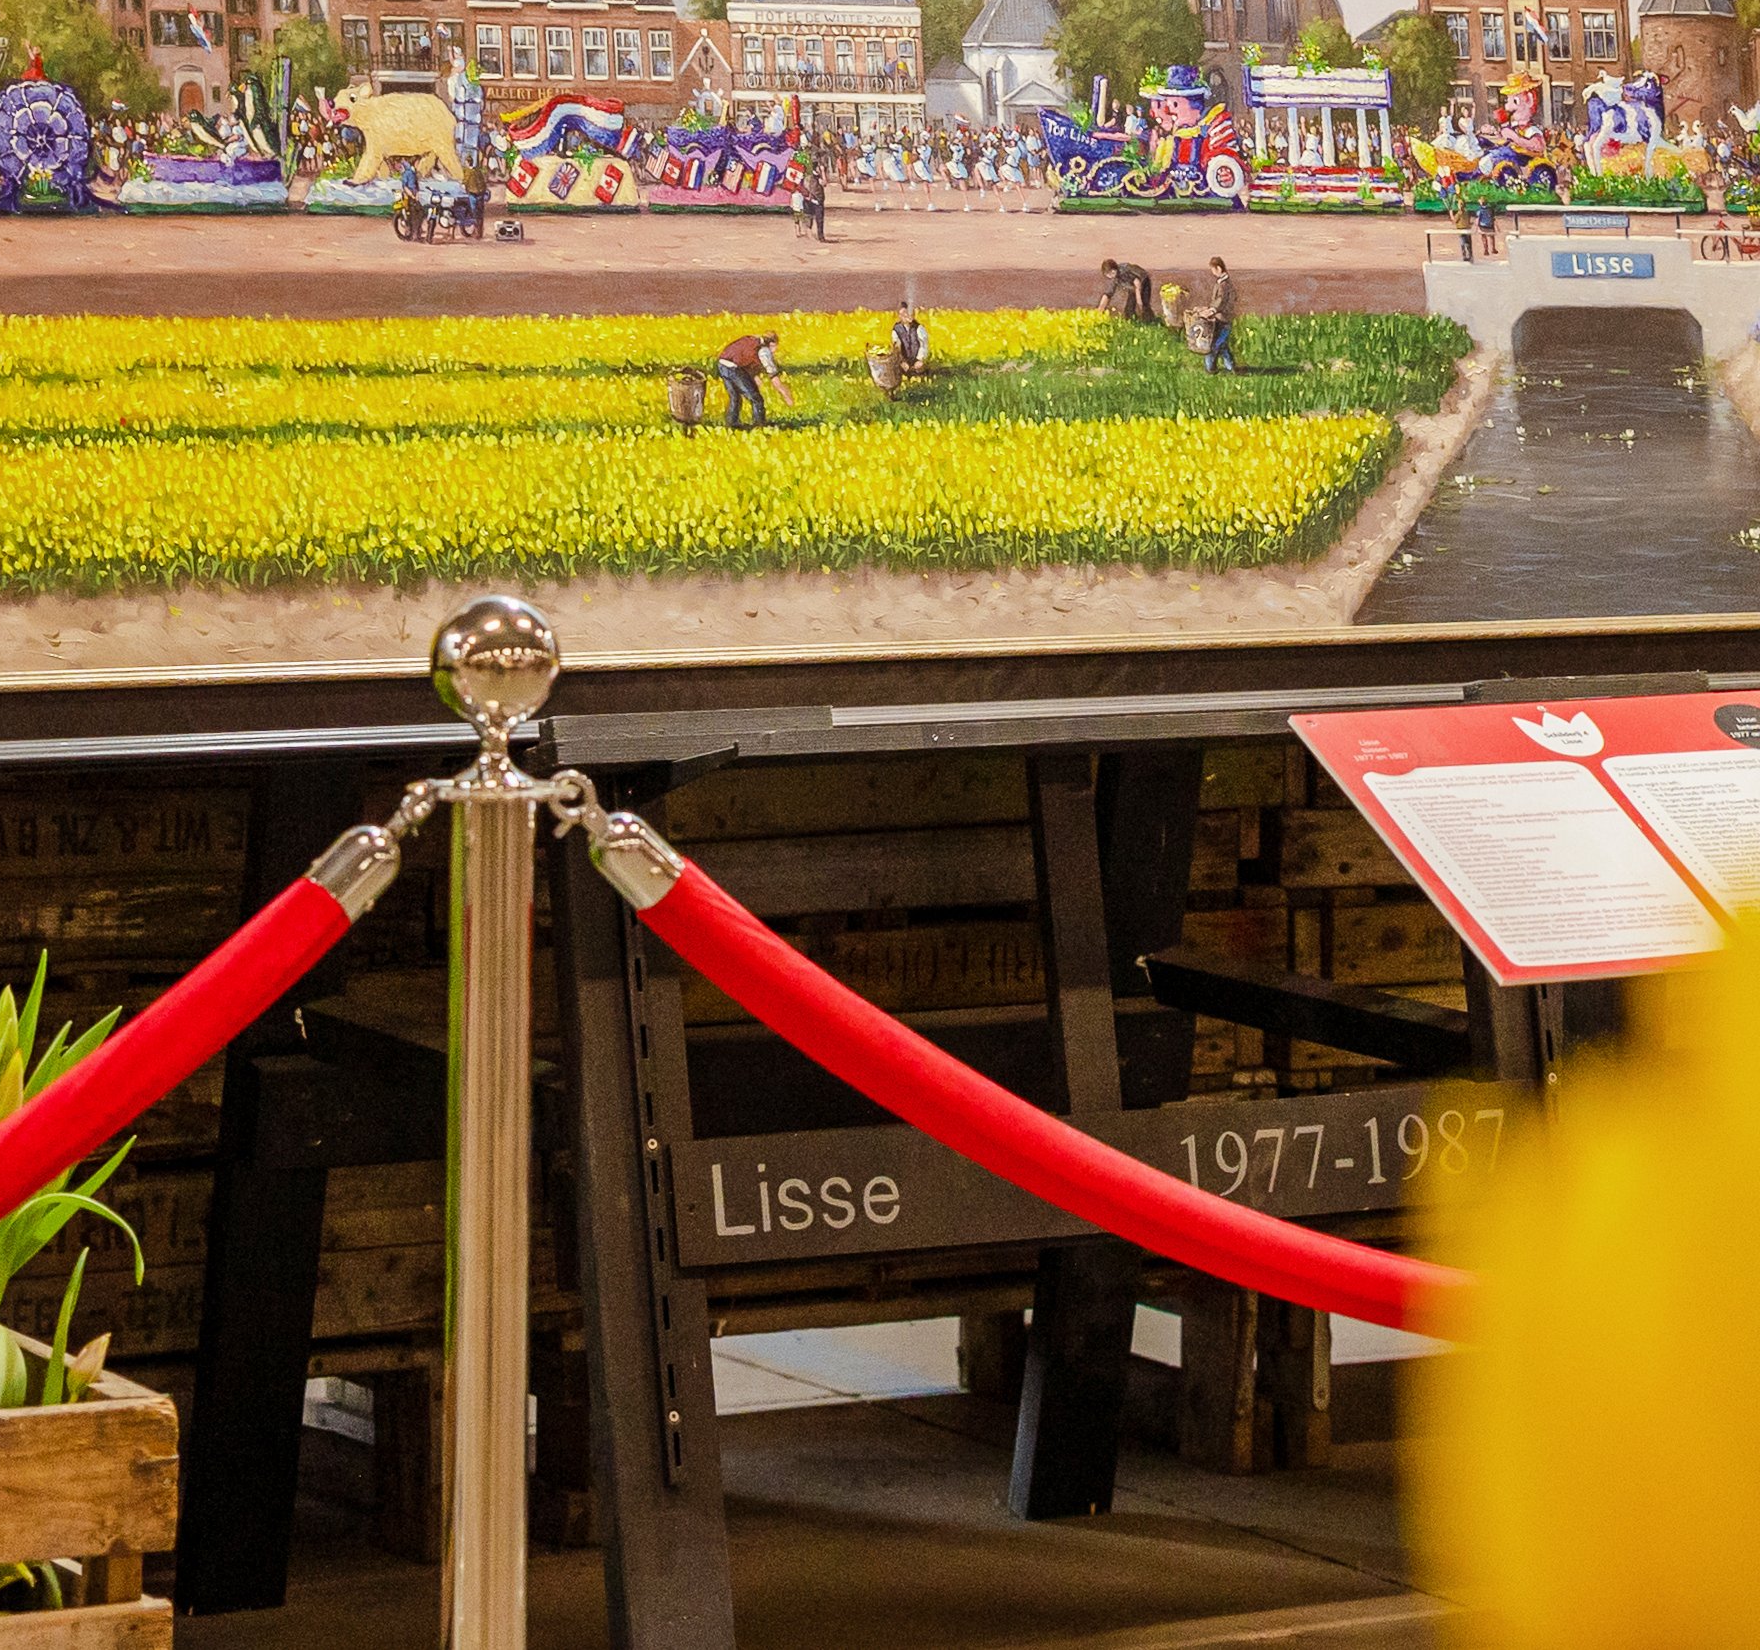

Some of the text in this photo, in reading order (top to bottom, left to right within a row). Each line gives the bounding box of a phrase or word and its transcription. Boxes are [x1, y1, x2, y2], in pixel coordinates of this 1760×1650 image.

[755, 10, 913, 25] HOTEL DE WITTE ZWAAN
[1571, 252, 1634, 275] Lisse
[710, 1108, 1508, 1237] Lisse 1977-1987
